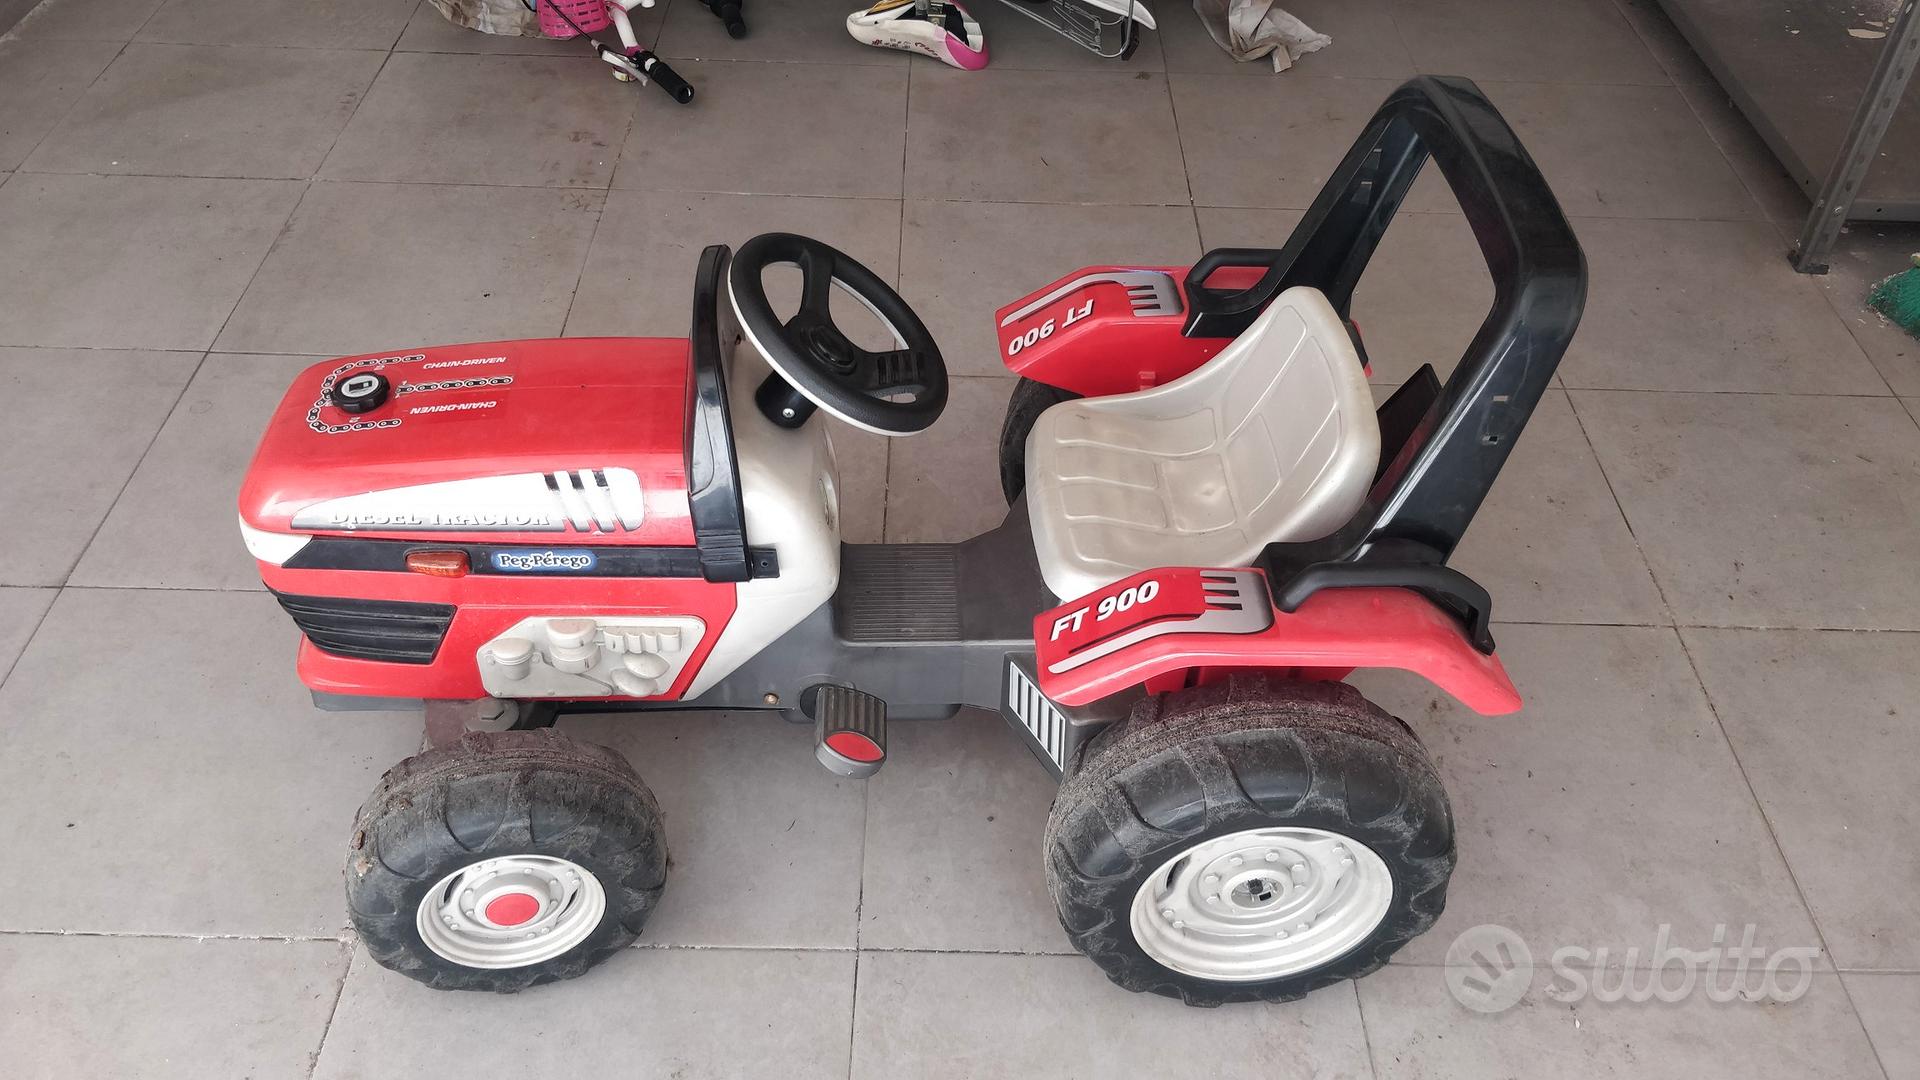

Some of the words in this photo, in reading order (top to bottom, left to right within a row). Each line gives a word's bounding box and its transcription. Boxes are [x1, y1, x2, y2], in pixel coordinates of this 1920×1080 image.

[1062, 299, 1094, 328] FT
[1008, 318, 1056, 356] 900
[423, 357, 507, 370] CHAIN-DRIVEN
[410, 400, 497, 415] CHAIN-DRIVEN
[499, 551, 592, 570] Peg-Pérego
[1050, 607, 1090, 642] FT
[1096, 580, 1160, 622] 900
